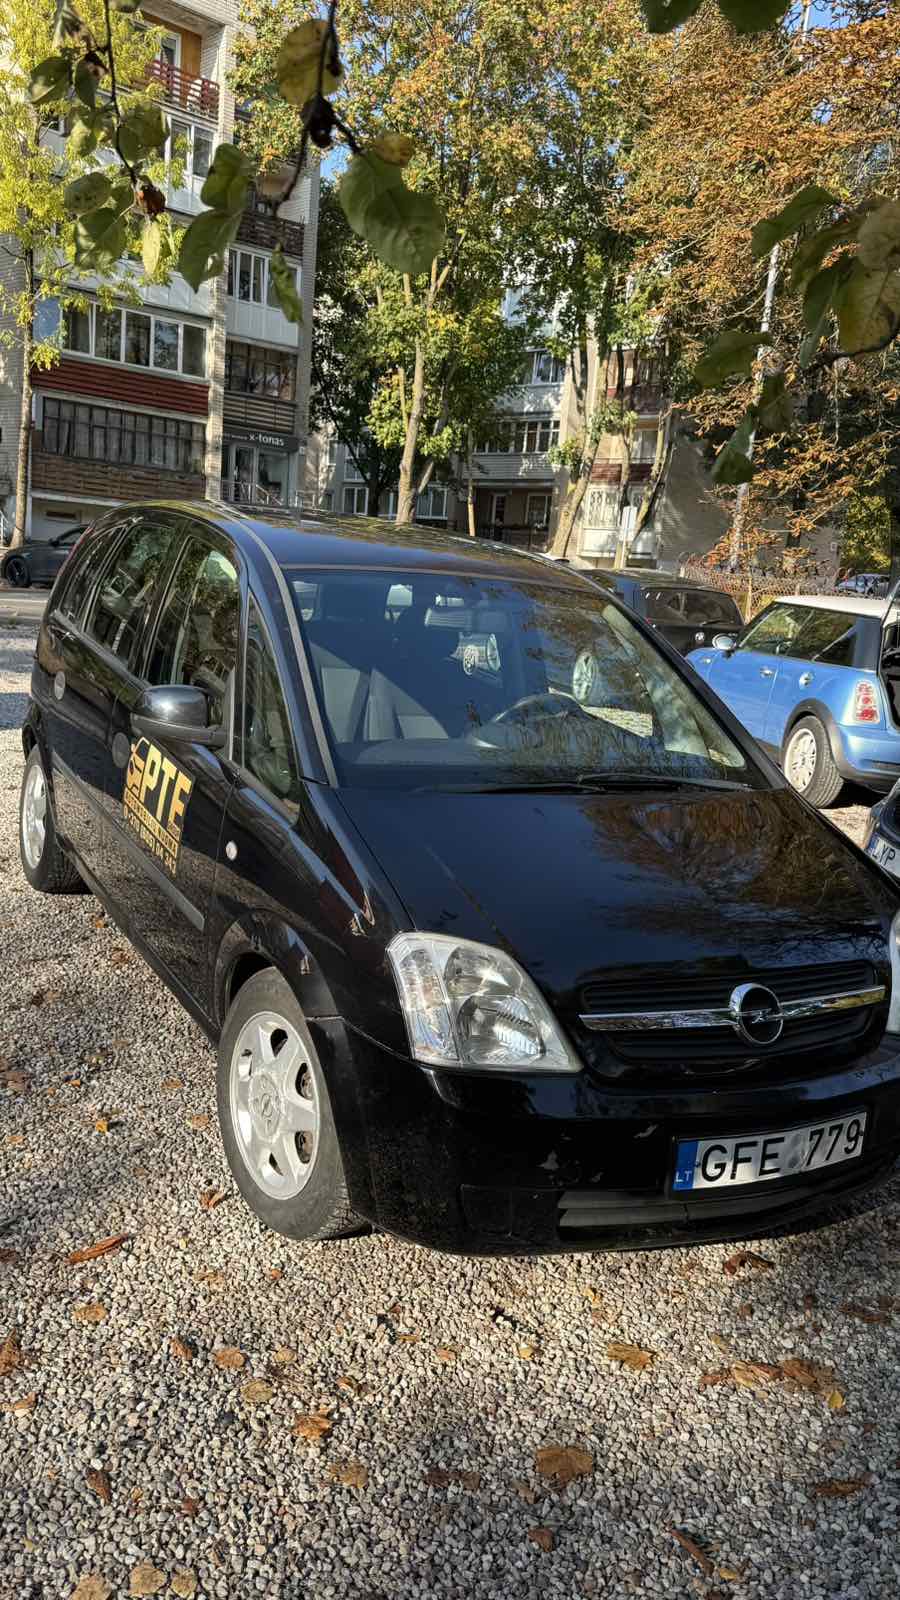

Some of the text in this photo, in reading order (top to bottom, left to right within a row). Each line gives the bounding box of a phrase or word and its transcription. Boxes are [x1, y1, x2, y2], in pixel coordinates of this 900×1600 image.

[138, 743, 193, 837] PTE
[675, 1171, 693, 1183] LT
[701, 1118, 861, 1182] GFE 779
